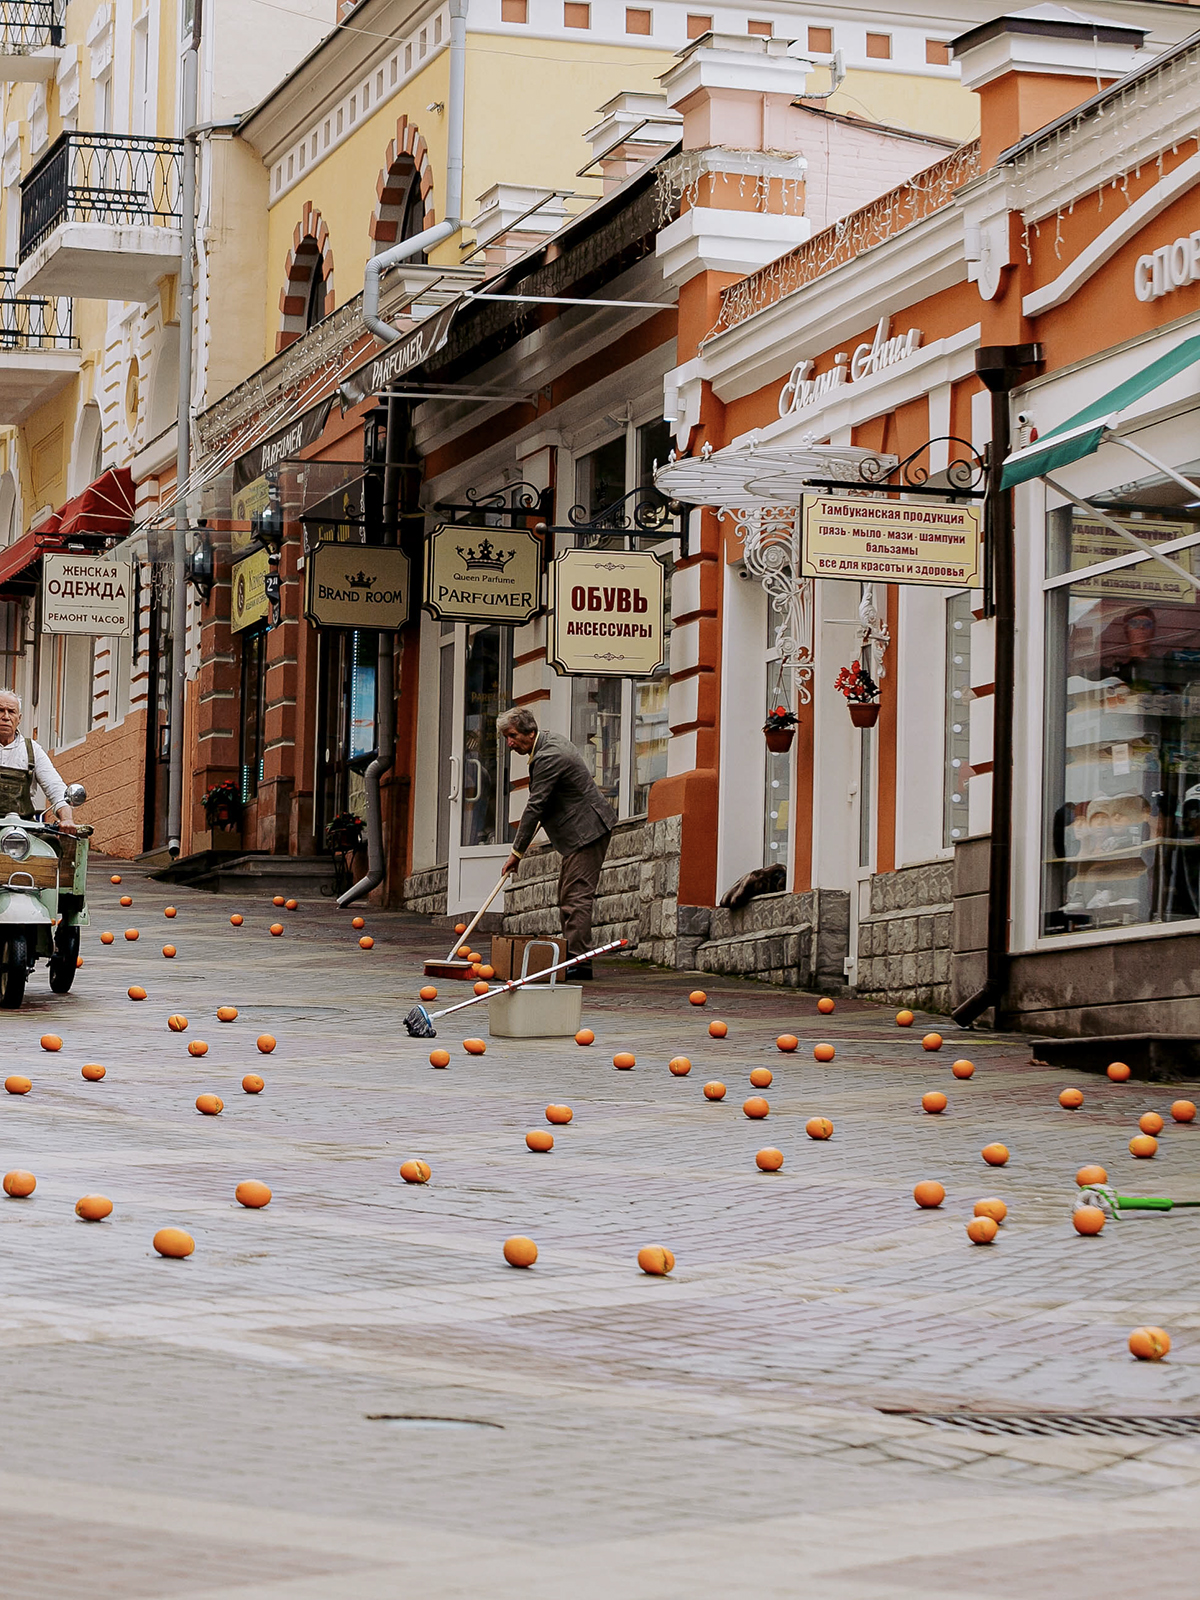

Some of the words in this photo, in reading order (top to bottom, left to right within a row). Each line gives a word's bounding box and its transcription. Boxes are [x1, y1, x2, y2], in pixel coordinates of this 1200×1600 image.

[371, 330, 424, 390] PARFUMER
[261, 421, 304, 472] PARFUMER
[821, 503, 901, 521] Тамбуканская
[903, 511, 964, 525] продукция
[818, 525, 846, 536] грязь
[852, 528, 881, 539] мыло
[887, 531, 913, 541] мази
[919, 533, 965, 545] шампуни
[865, 542, 918, 556] бальзамы
[62, 565, 117, 578] ЖЕНСКАЯ
[819, 559, 837, 568] все
[838, 561, 858, 571] для
[861, 562, 904, 573] красоты
[906, 565, 913, 573] и
[915, 565, 964, 577] здоровья
[453, 572, 480, 583] Queen
[482, 574, 516, 585] Parfume
[48, 579, 126, 601] ОДЕЖДА
[318, 583, 360, 603] BRAND
[365, 590, 403, 604] ROOM
[438, 585, 533, 608] PARFUMER
[571, 585, 648, 613] ОБУВЬ
[48, 612, 88, 622] РЕМОНТ
[91, 614, 125, 624] ЧАСОВ
[566, 621, 652, 638] АКСЕССУАРЫ
